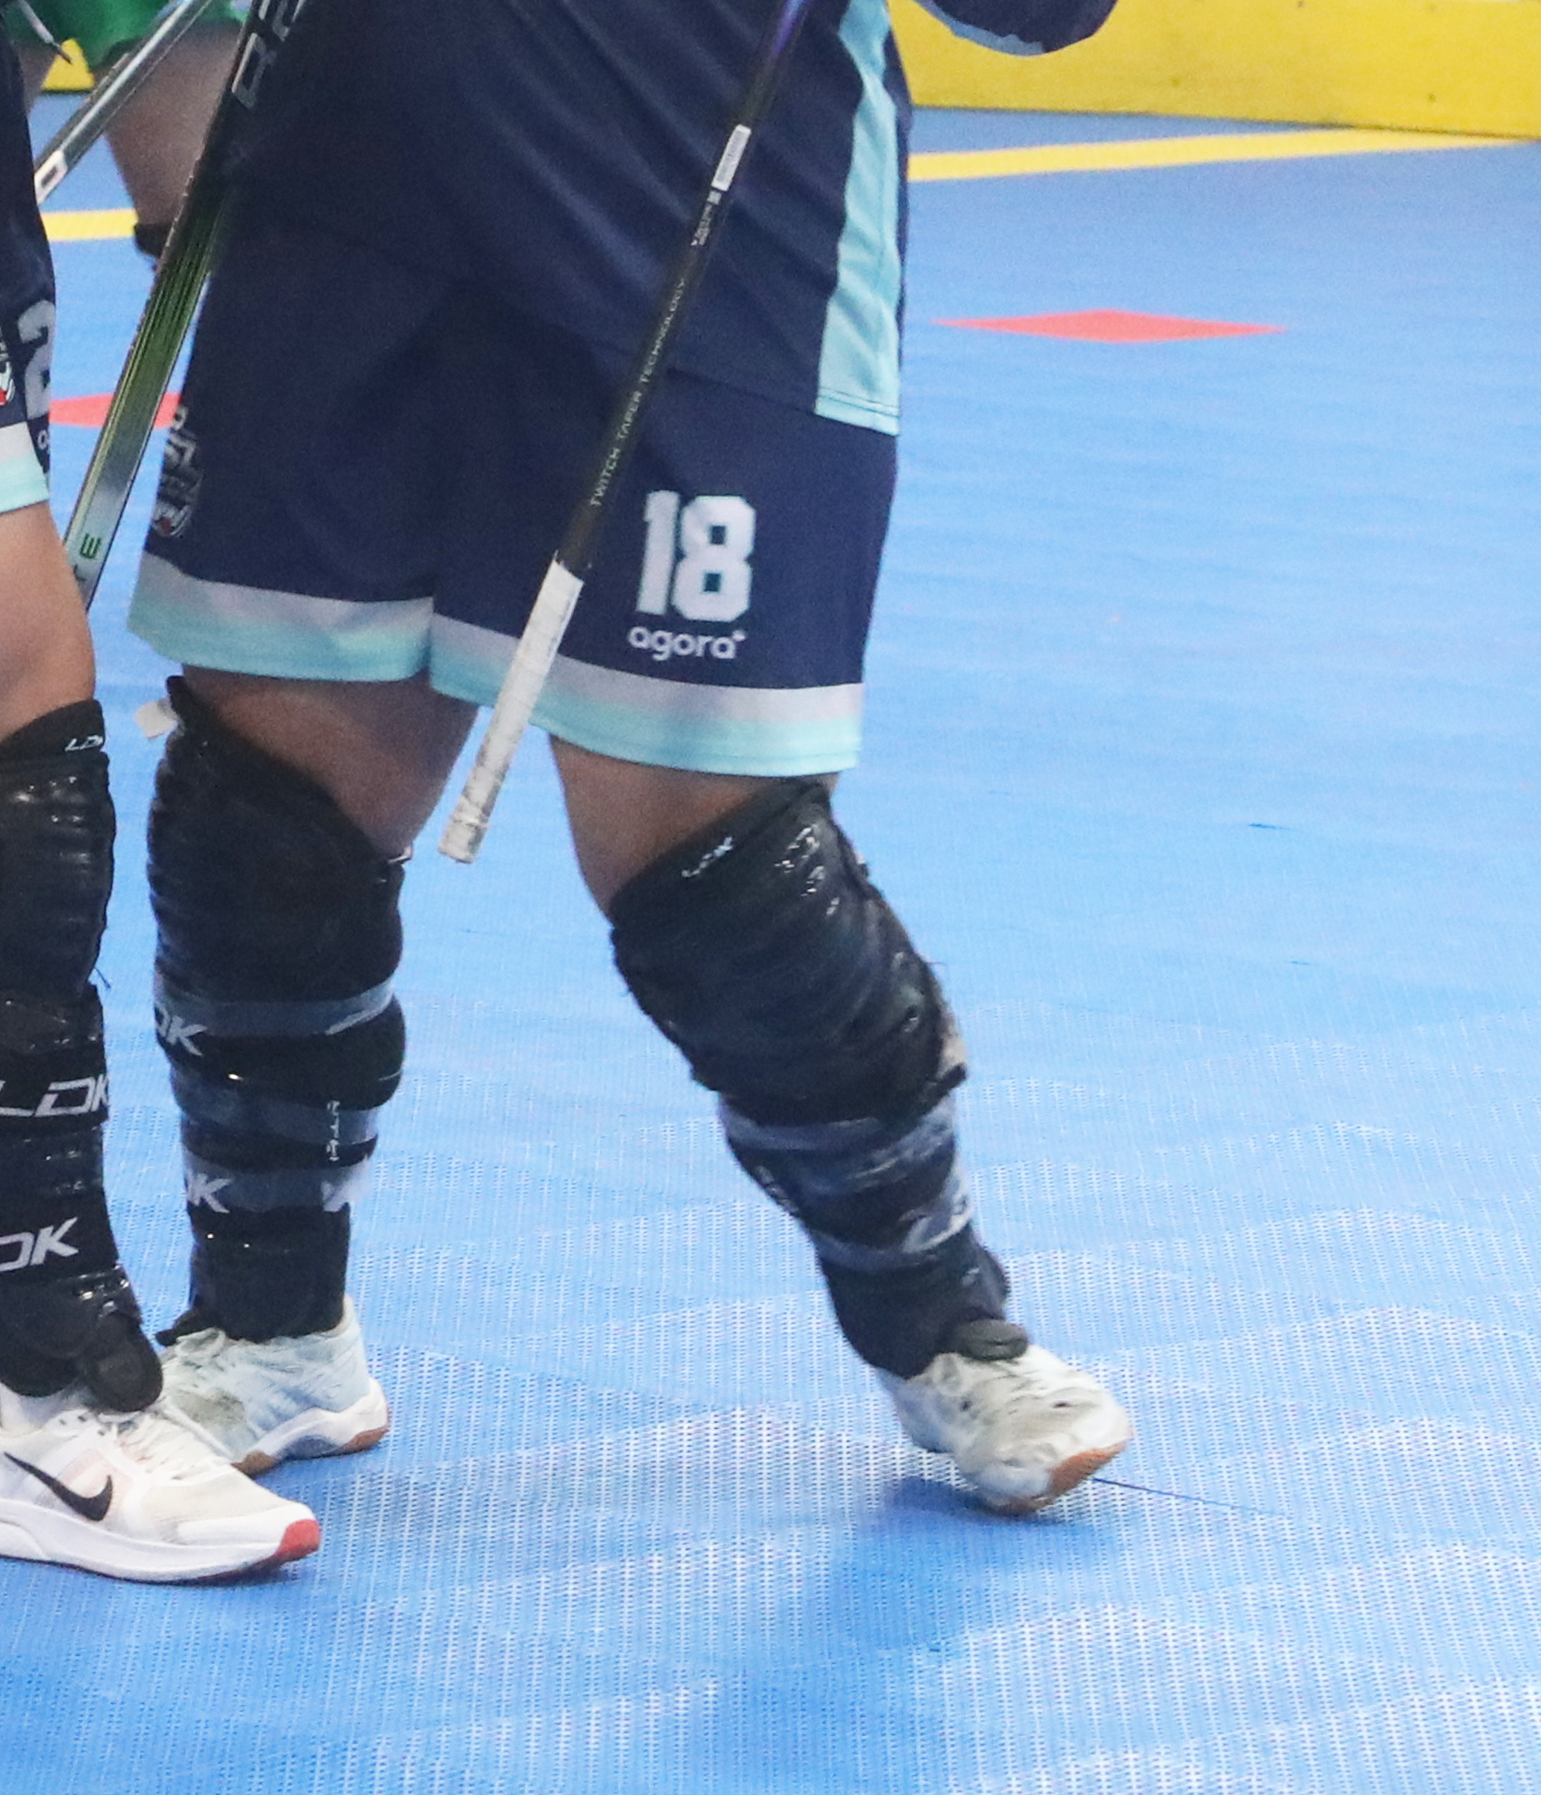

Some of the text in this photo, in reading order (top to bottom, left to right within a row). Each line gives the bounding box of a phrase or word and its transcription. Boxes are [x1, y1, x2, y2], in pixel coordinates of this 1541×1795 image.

[589, 446, 621, 508] TWITCH
[616, 389, 643, 441] TAPER
[634, 490, 758, 623] 18
[627, 626, 737, 662] agora
